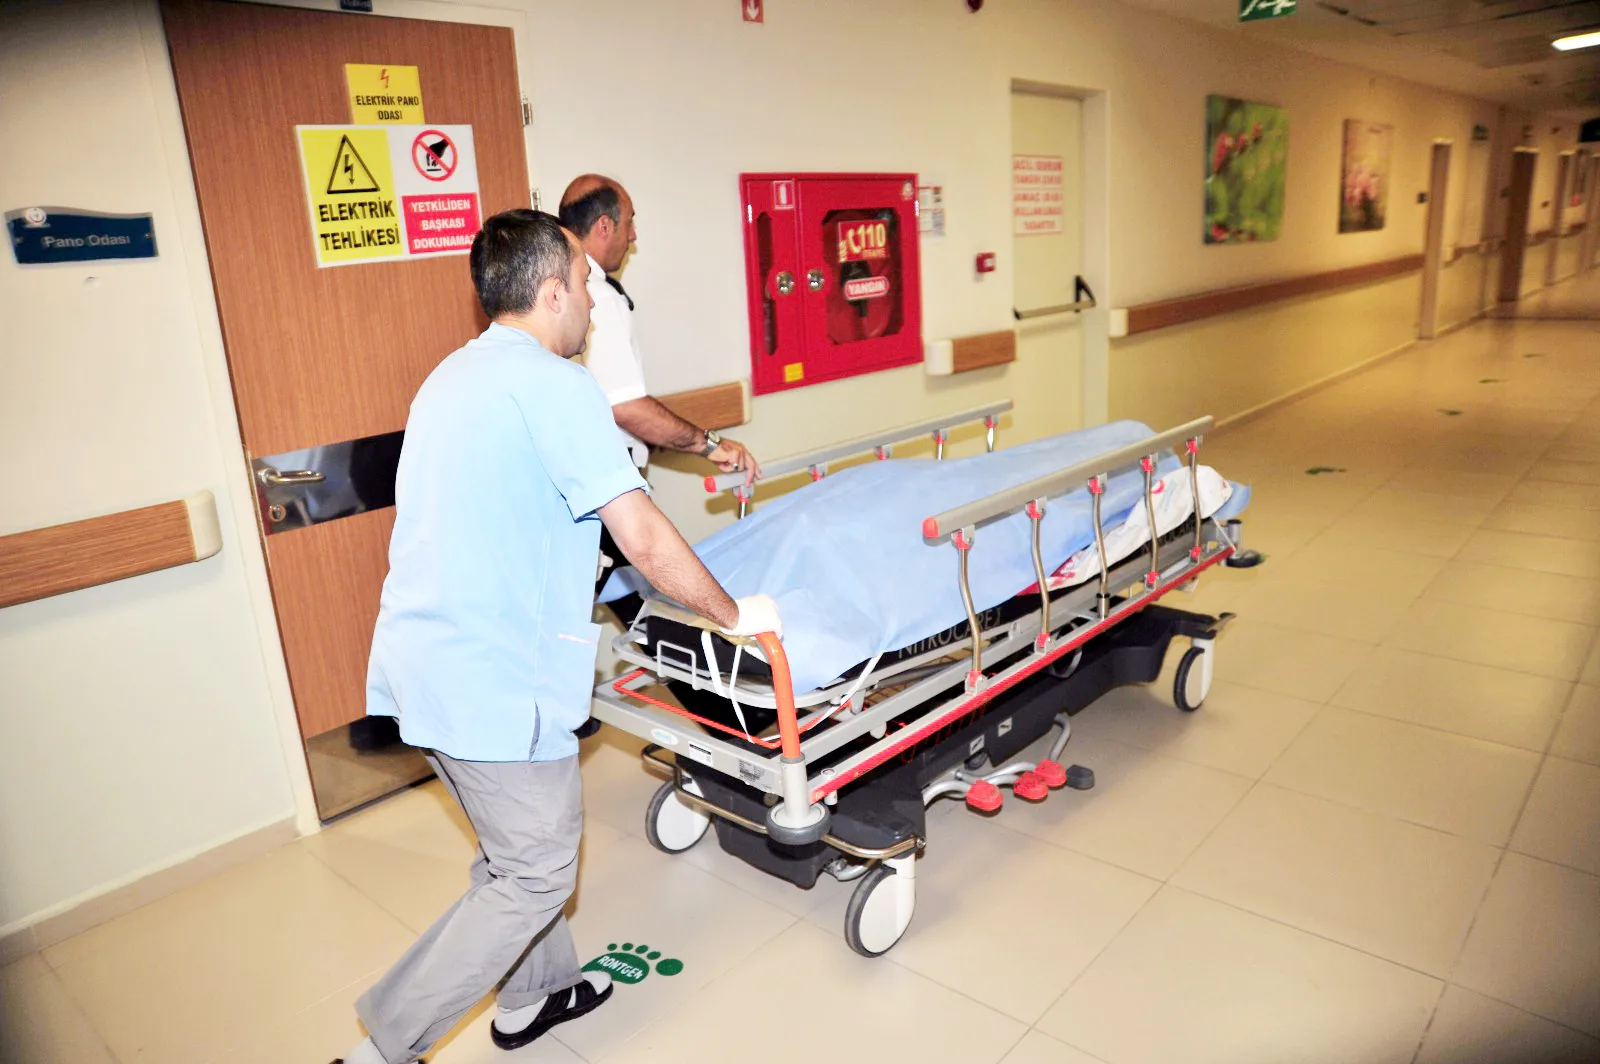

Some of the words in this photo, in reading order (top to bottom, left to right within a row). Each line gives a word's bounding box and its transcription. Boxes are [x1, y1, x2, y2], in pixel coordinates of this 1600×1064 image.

[356, 94, 395, 106] ELEKTRİK
[397, 96, 419, 106] PANO
[377, 110, 403, 120] ODASI
[318, 197, 395, 222] ELEKTRİK
[411, 199, 470, 212] YETKİLİDEN
[421, 219, 465, 231] BAŞKASI
[44, 236, 85, 248] Pano
[88, 234, 131, 246] Odası
[320, 223, 400, 251] TEHLİKESİ
[858, 223, 886, 250] 110
[847, 279, 886, 295] YANGIN
